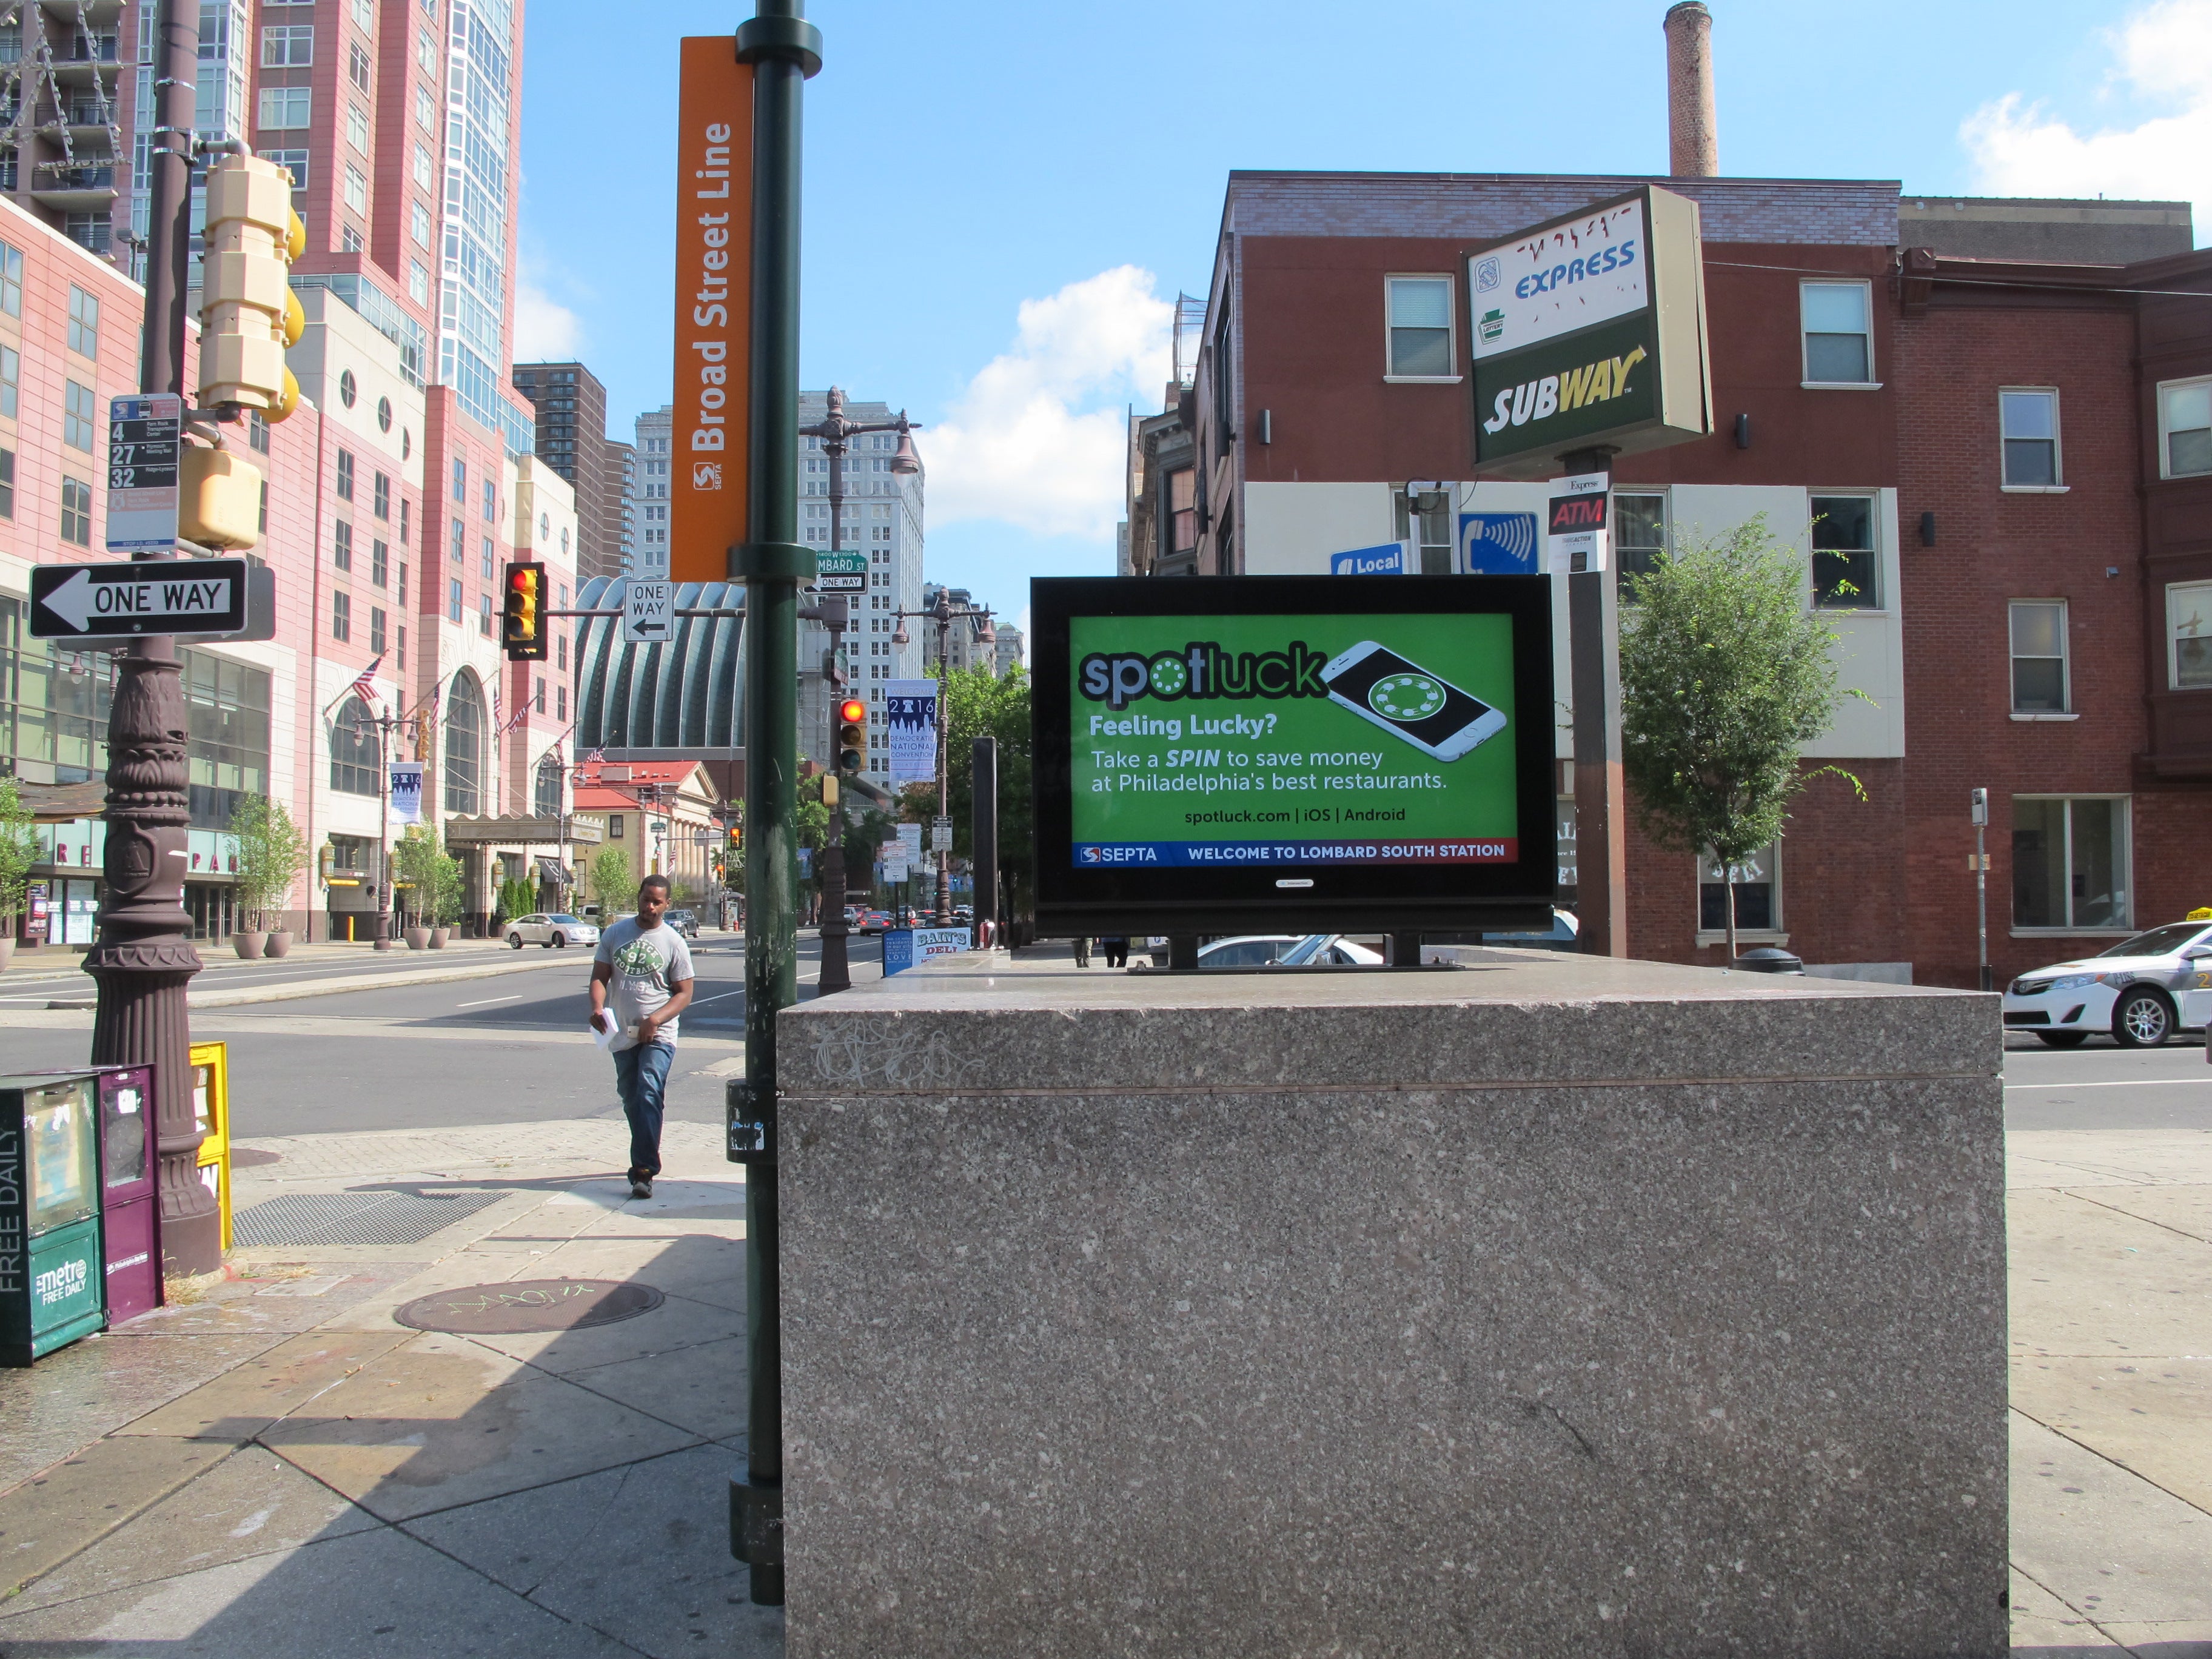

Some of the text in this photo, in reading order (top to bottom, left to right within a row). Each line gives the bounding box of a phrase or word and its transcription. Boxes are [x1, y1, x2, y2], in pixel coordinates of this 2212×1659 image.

[1515, 240, 1635, 299] EXPRESS
[692, 124, 730, 451] Broad Street Line
[1483, 323, 1503, 332] LOTTERY
[1484, 344, 1647, 435] SUBWAY
[113, 423, 124, 441] 4
[112, 445, 135, 464] 27
[112, 468, 135, 488] 32
[1571, 481, 1599, 491] Express
[1552, 498, 1604, 527] ATM
[818, 560, 853, 571] MBARD
[1357, 552, 1398, 574] Local
[842, 578, 859, 586] WAY
[95, 583, 221, 613] ONE WAY
[635, 586, 664, 599] ONE
[632, 602, 665, 615] WAY
[1084, 646, 1323, 705] spotluck
[1090, 713, 1277, 740] Feeling Lucky?
[1091, 749, 1383, 769] Take a SPIN to save money
[1091, 773, 1447, 795] at Philadelphia's best restaurants.
[1185, 808, 1405, 825] spotluck.com iOS Android
[1102, 844, 1504, 862] SEPTA WELCOME TO LOMBARD SOUTH STATION
[917, 931, 967, 947] BAIN'S
[628, 951, 646, 964] 92
[925, 946, 957, 955] DELI
[615, 956, 659, 974] FOOTBALL
[0, 1130, 22, 1292] FREE DAILY
[41, 1259, 87, 1293] metro
[42, 1278, 87, 1306] FREE DAILY
